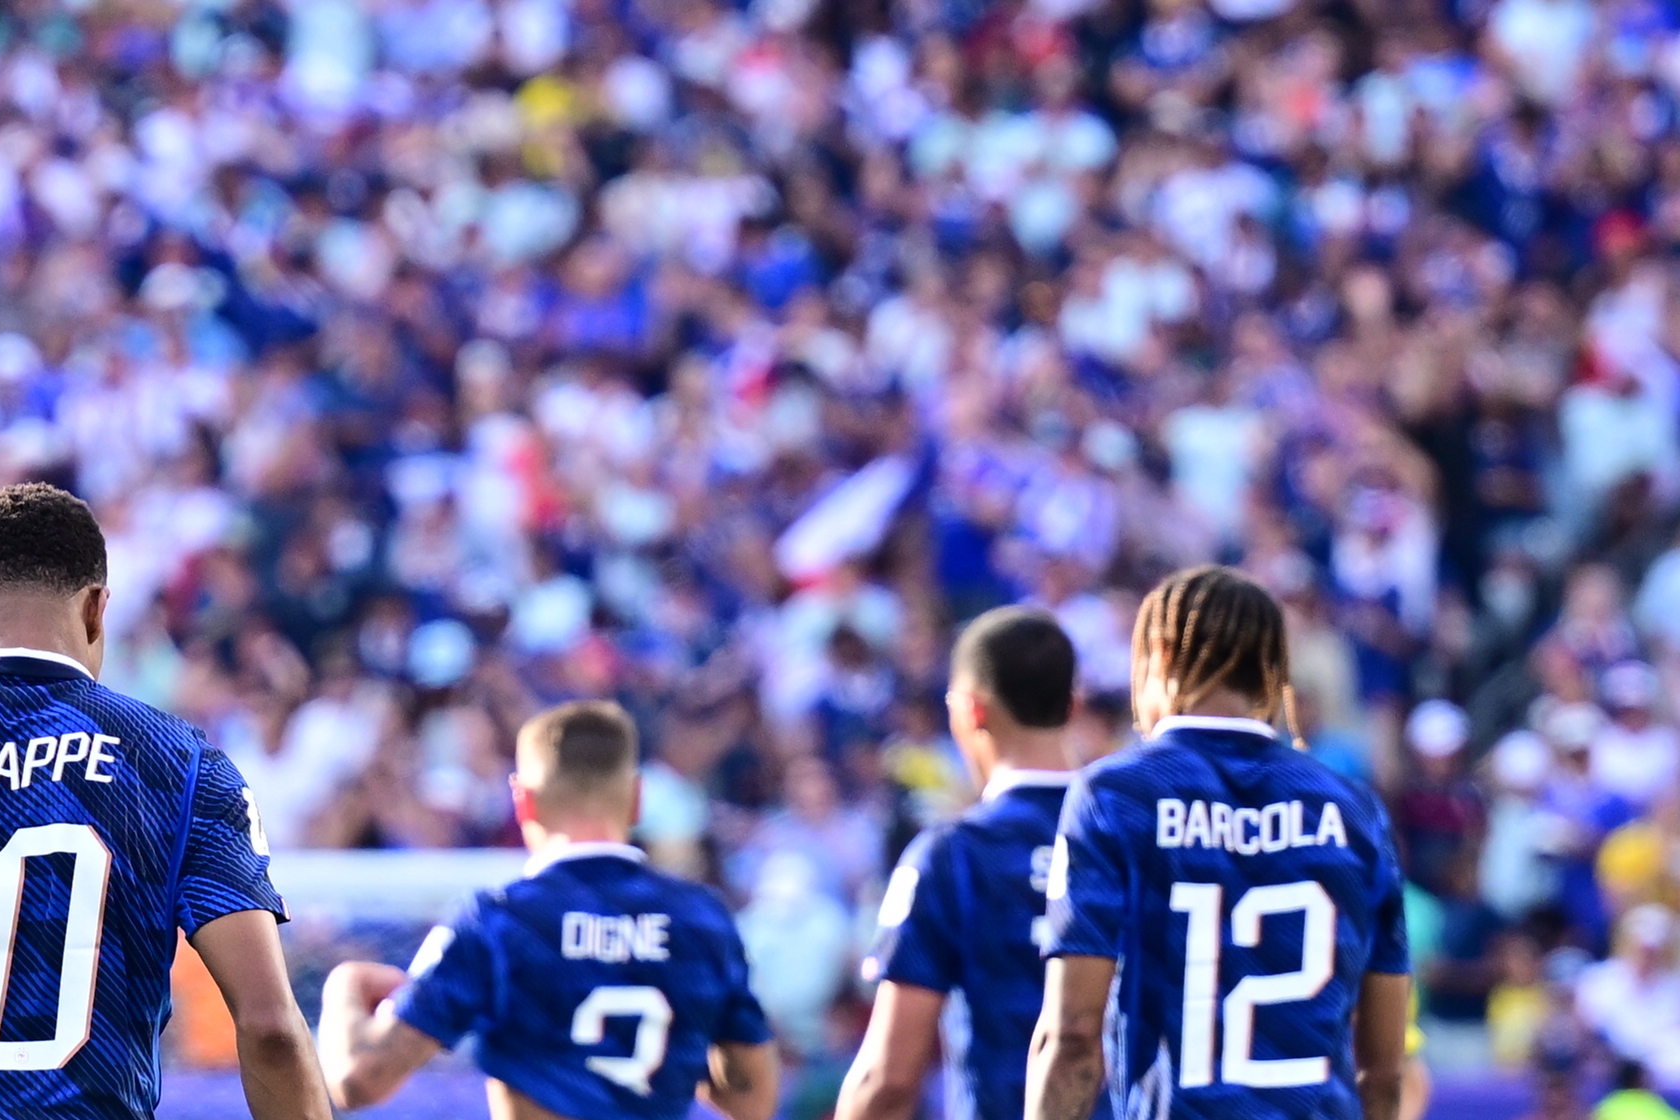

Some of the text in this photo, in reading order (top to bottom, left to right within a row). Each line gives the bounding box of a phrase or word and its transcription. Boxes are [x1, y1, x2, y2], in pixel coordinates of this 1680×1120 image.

[1156, 797, 1348, 856] BARCOLA
[560, 911, 672, 965] DIGNE
[1169, 880, 1336, 1089] 12
